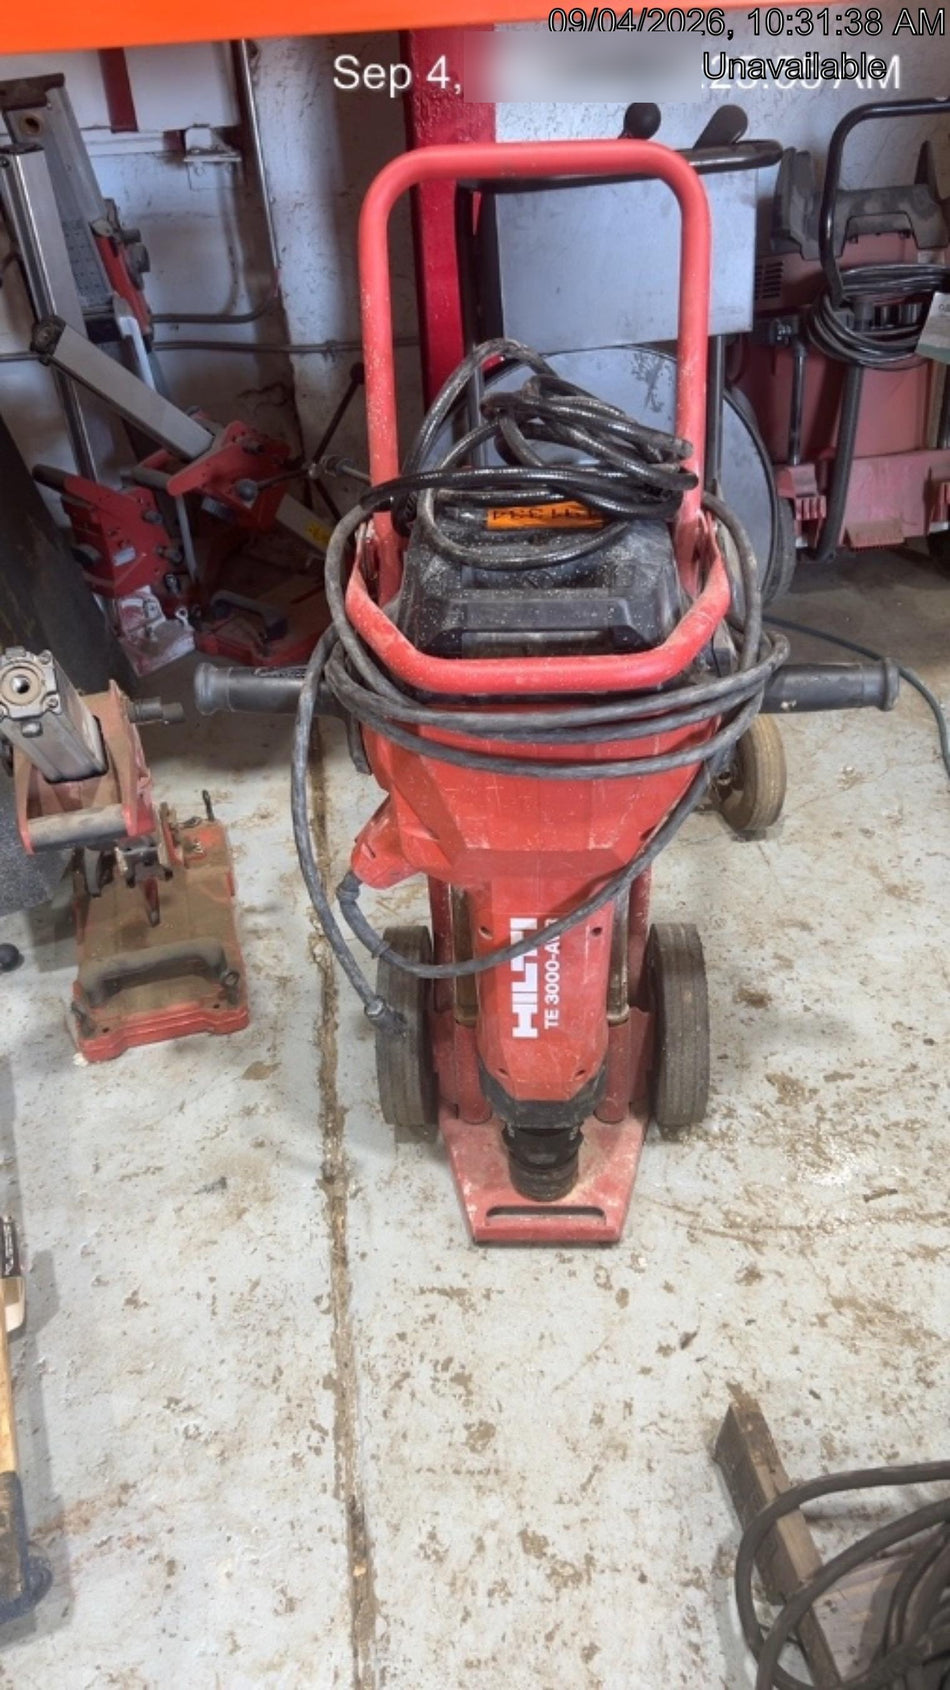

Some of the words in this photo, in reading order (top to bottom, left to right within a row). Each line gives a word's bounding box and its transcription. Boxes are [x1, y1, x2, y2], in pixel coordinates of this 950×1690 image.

[510, 917, 539, 1039] HILTI
[544, 918, 561, 1005] 3000-A
[544, 1009, 560, 1030] TE
